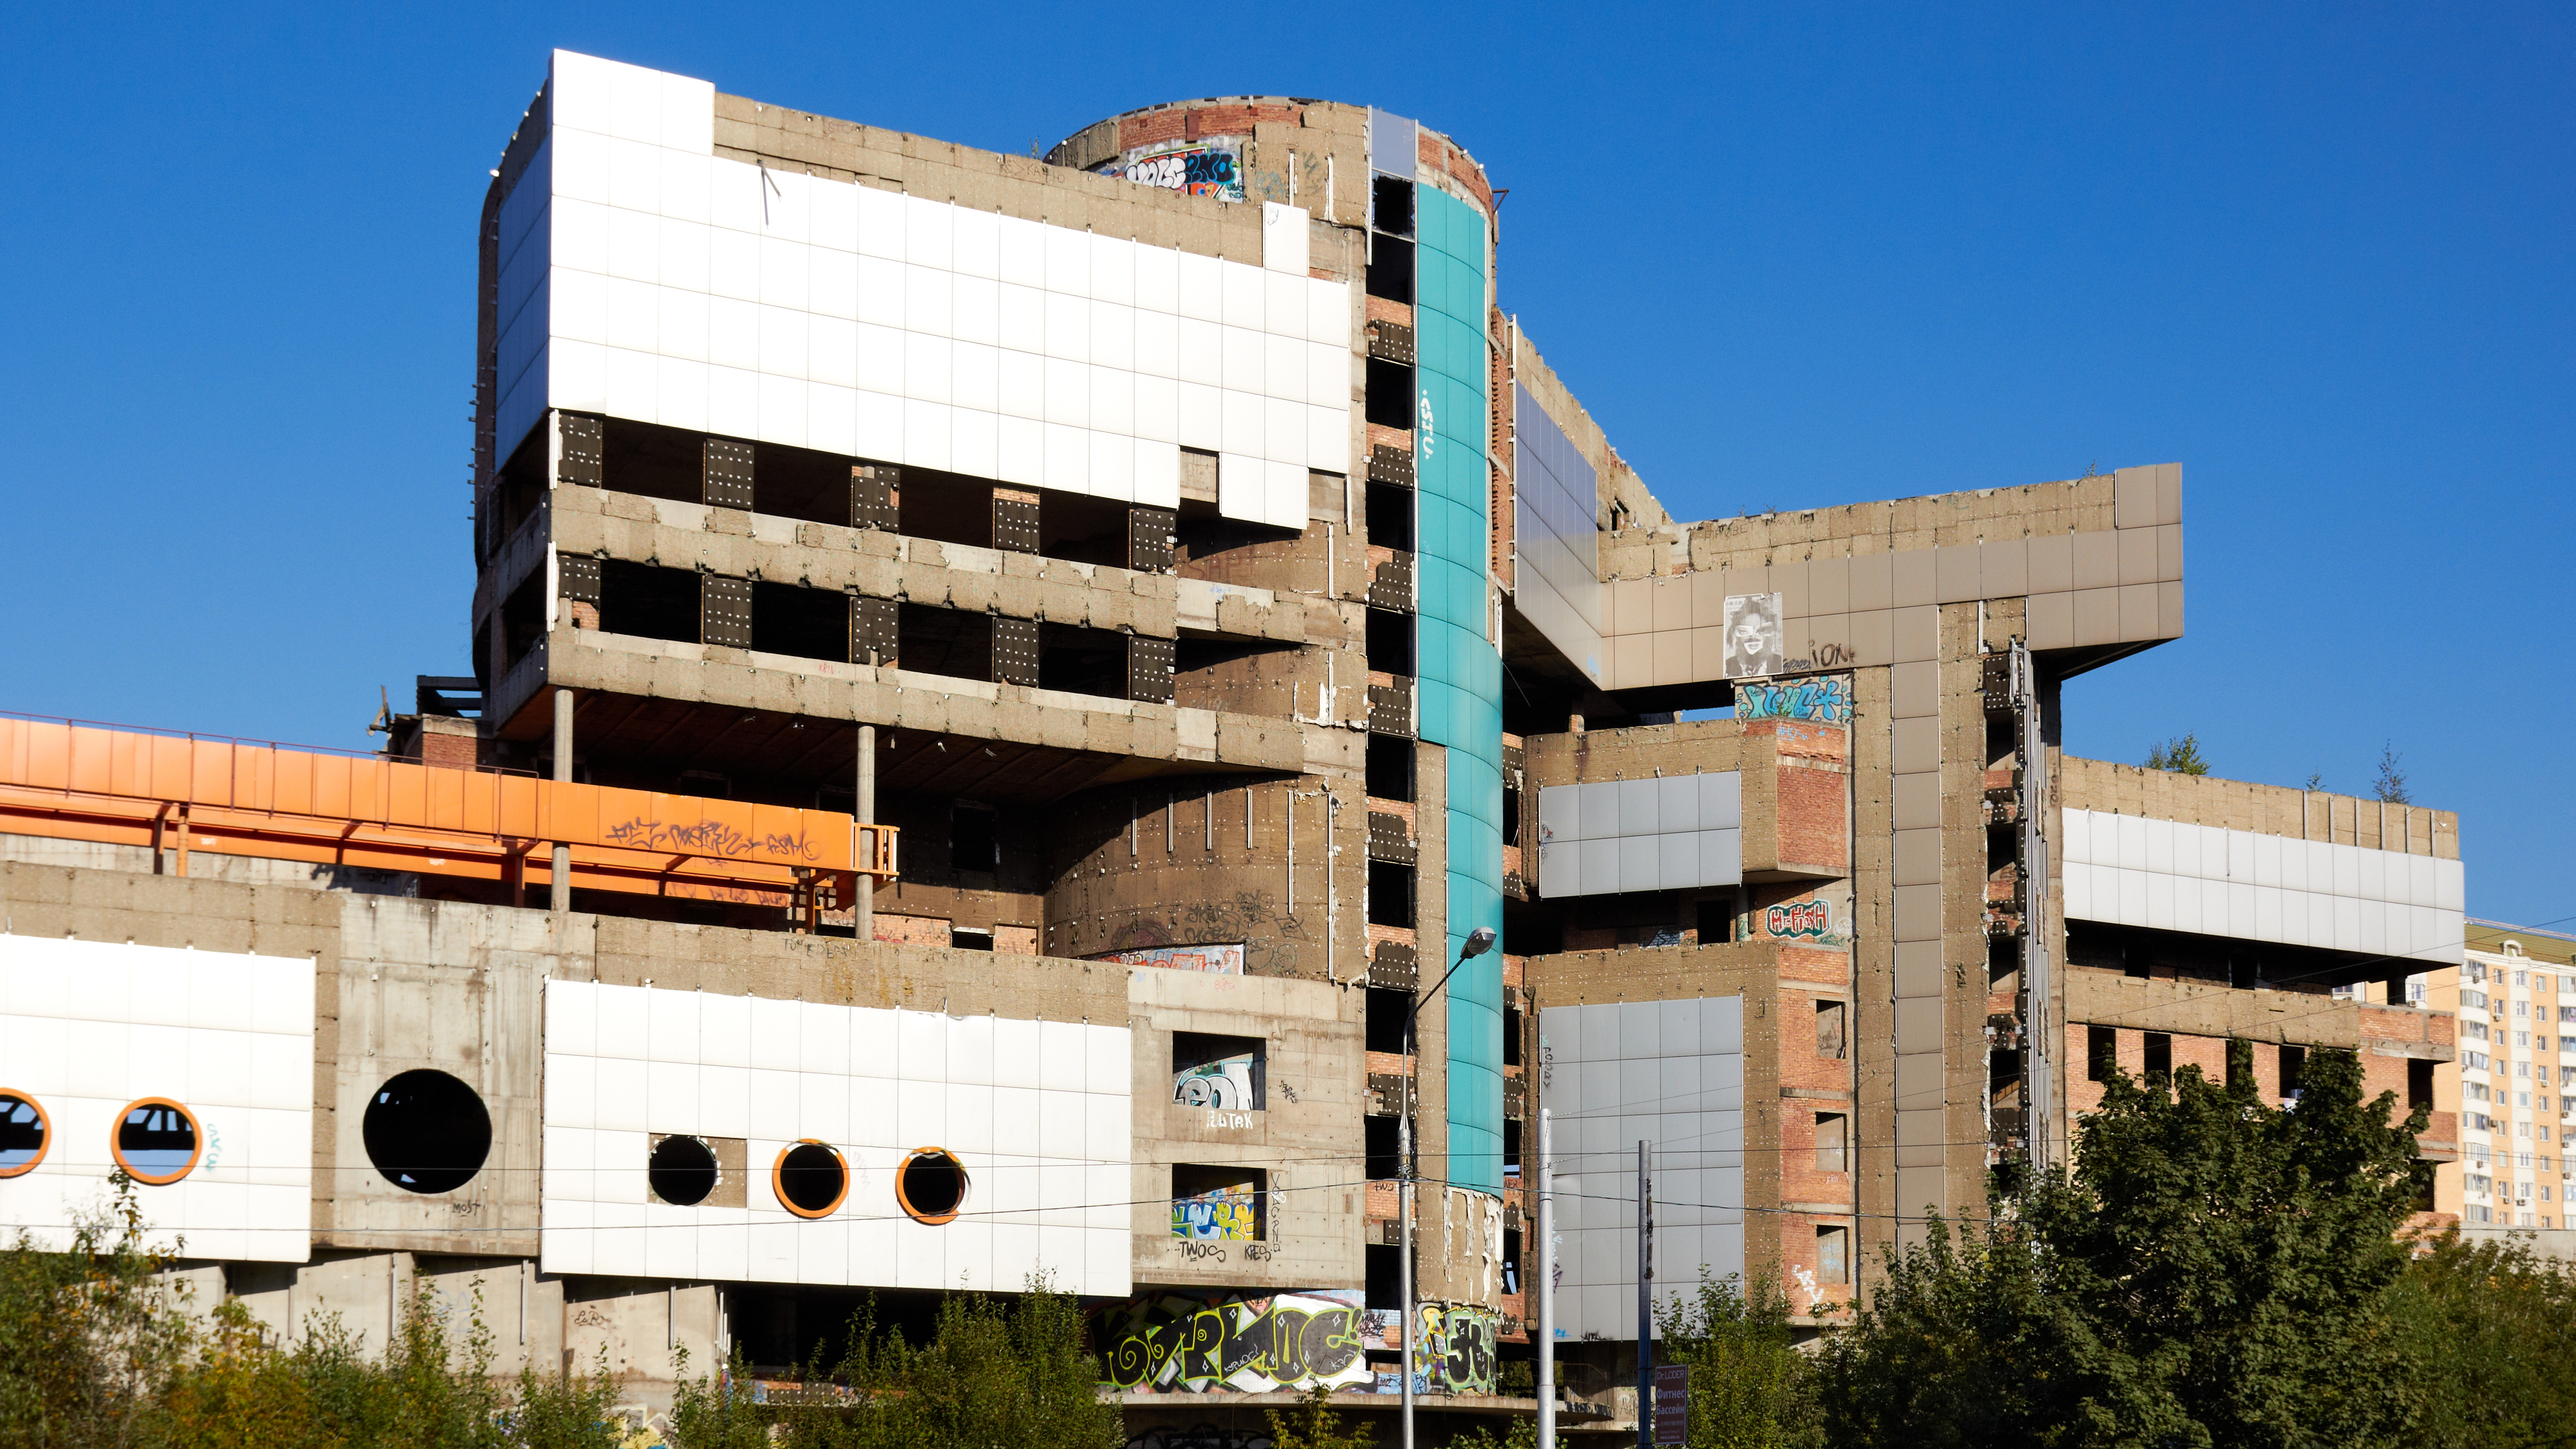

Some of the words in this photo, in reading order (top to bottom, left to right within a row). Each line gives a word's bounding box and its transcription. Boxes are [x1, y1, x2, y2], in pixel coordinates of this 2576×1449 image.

[1665, 1369, 1685, 1379] LODER
[1656, 1388, 1685, 1400] Фитнес
[1656, 1403, 1685, 1415] Бассейн
